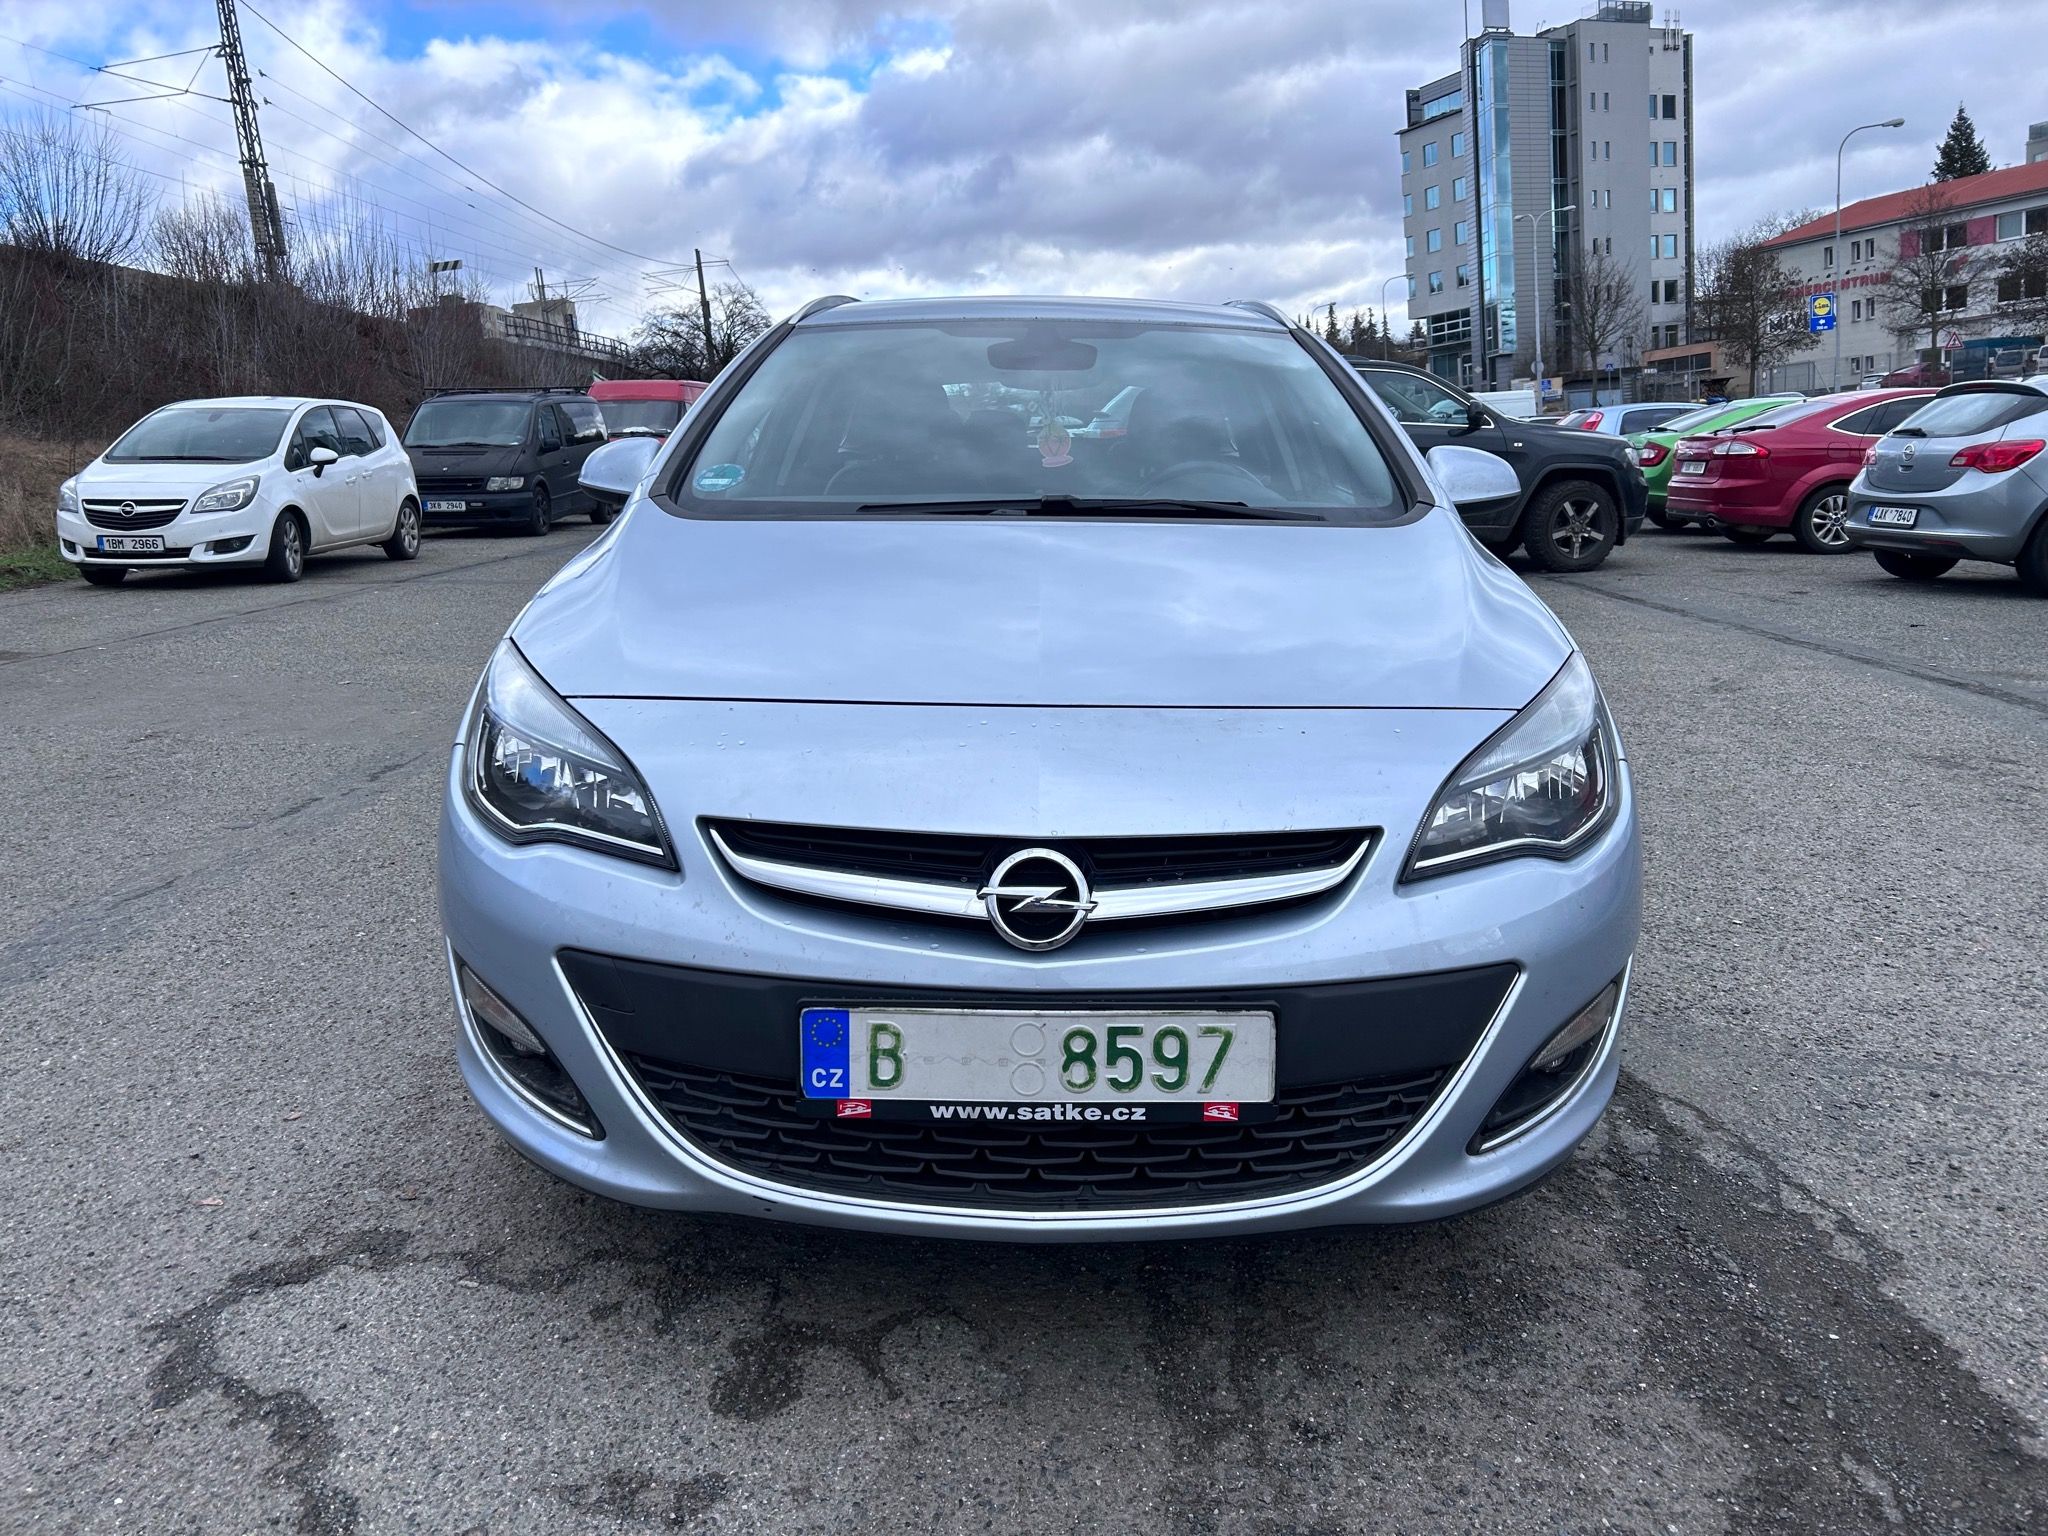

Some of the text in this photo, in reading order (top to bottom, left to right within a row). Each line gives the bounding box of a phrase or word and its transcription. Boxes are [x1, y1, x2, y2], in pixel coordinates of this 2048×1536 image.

[1874, 508, 1913, 523] 4AK 7840
[106, 539, 159, 550] 1BM 2966
[1008, 848, 1070, 865] OPEL
[866, 1020, 1237, 1094] B 8597
[811, 1068, 844, 1088] CZ
[929, 1103, 1147, 1122] www.satke.cz
